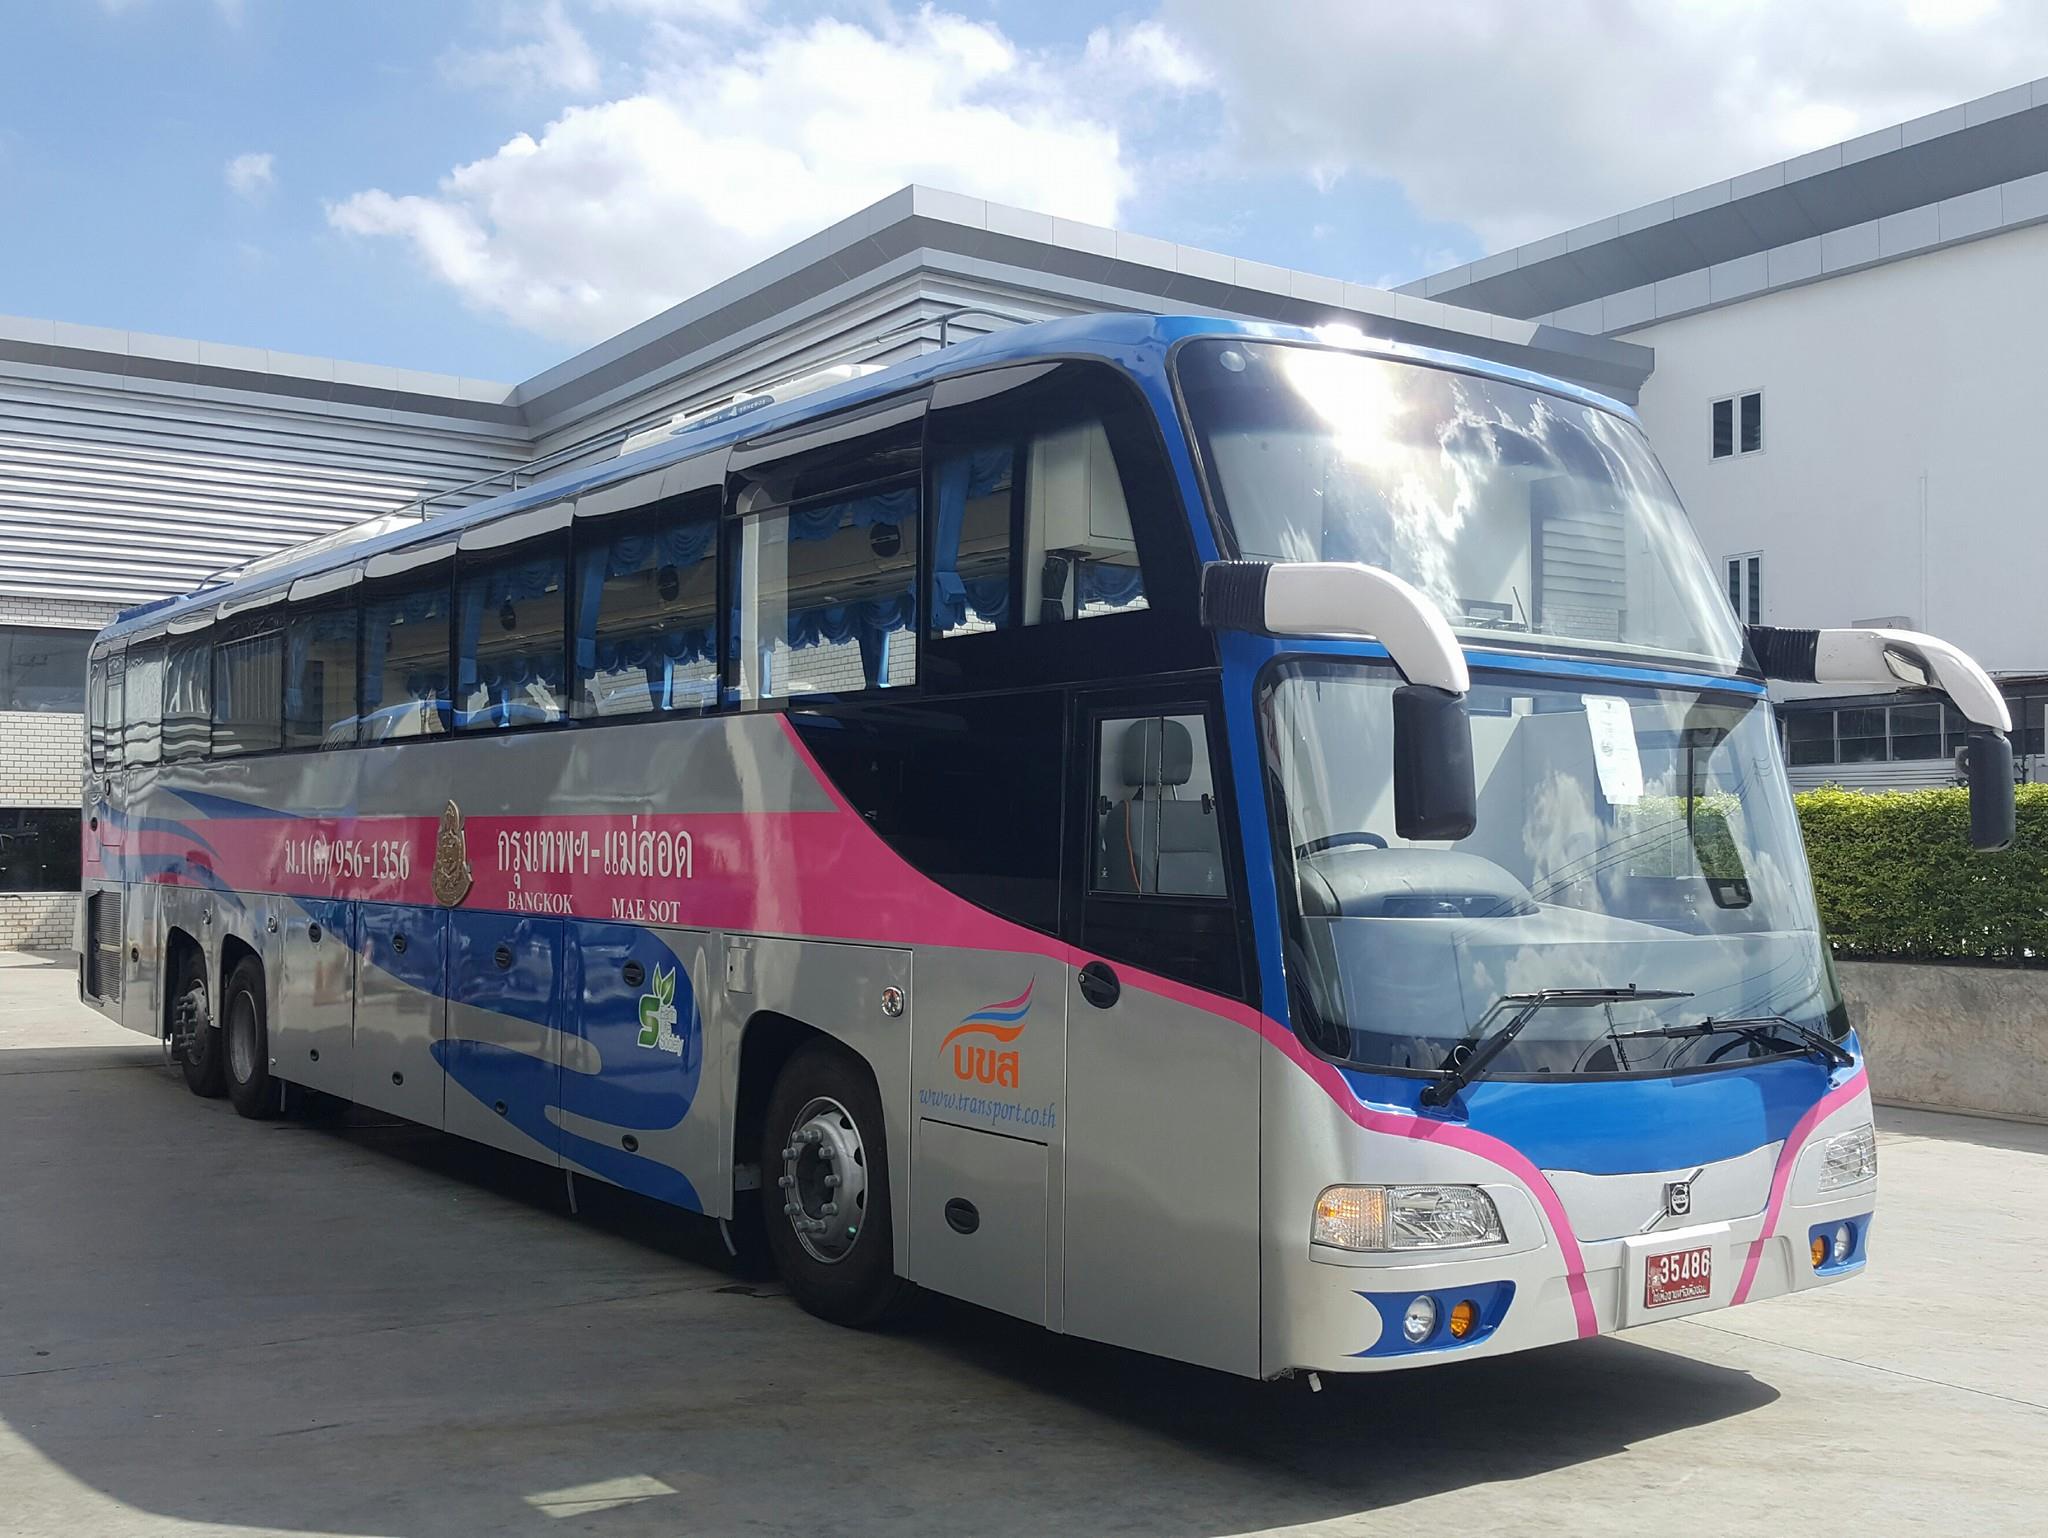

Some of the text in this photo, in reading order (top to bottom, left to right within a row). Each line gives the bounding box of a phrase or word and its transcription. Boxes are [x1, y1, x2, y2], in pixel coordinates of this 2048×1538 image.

[497, 815, 693, 889] กรุงเทพฯ-แม่สอด
[508, 890, 681, 924] BANGKOK MAE SOT
[953, 1044, 1019, 1089] บขส
[919, 1089, 1057, 1129] www.transport.co.th
[1660, 1250, 1710, 1284] 35486
